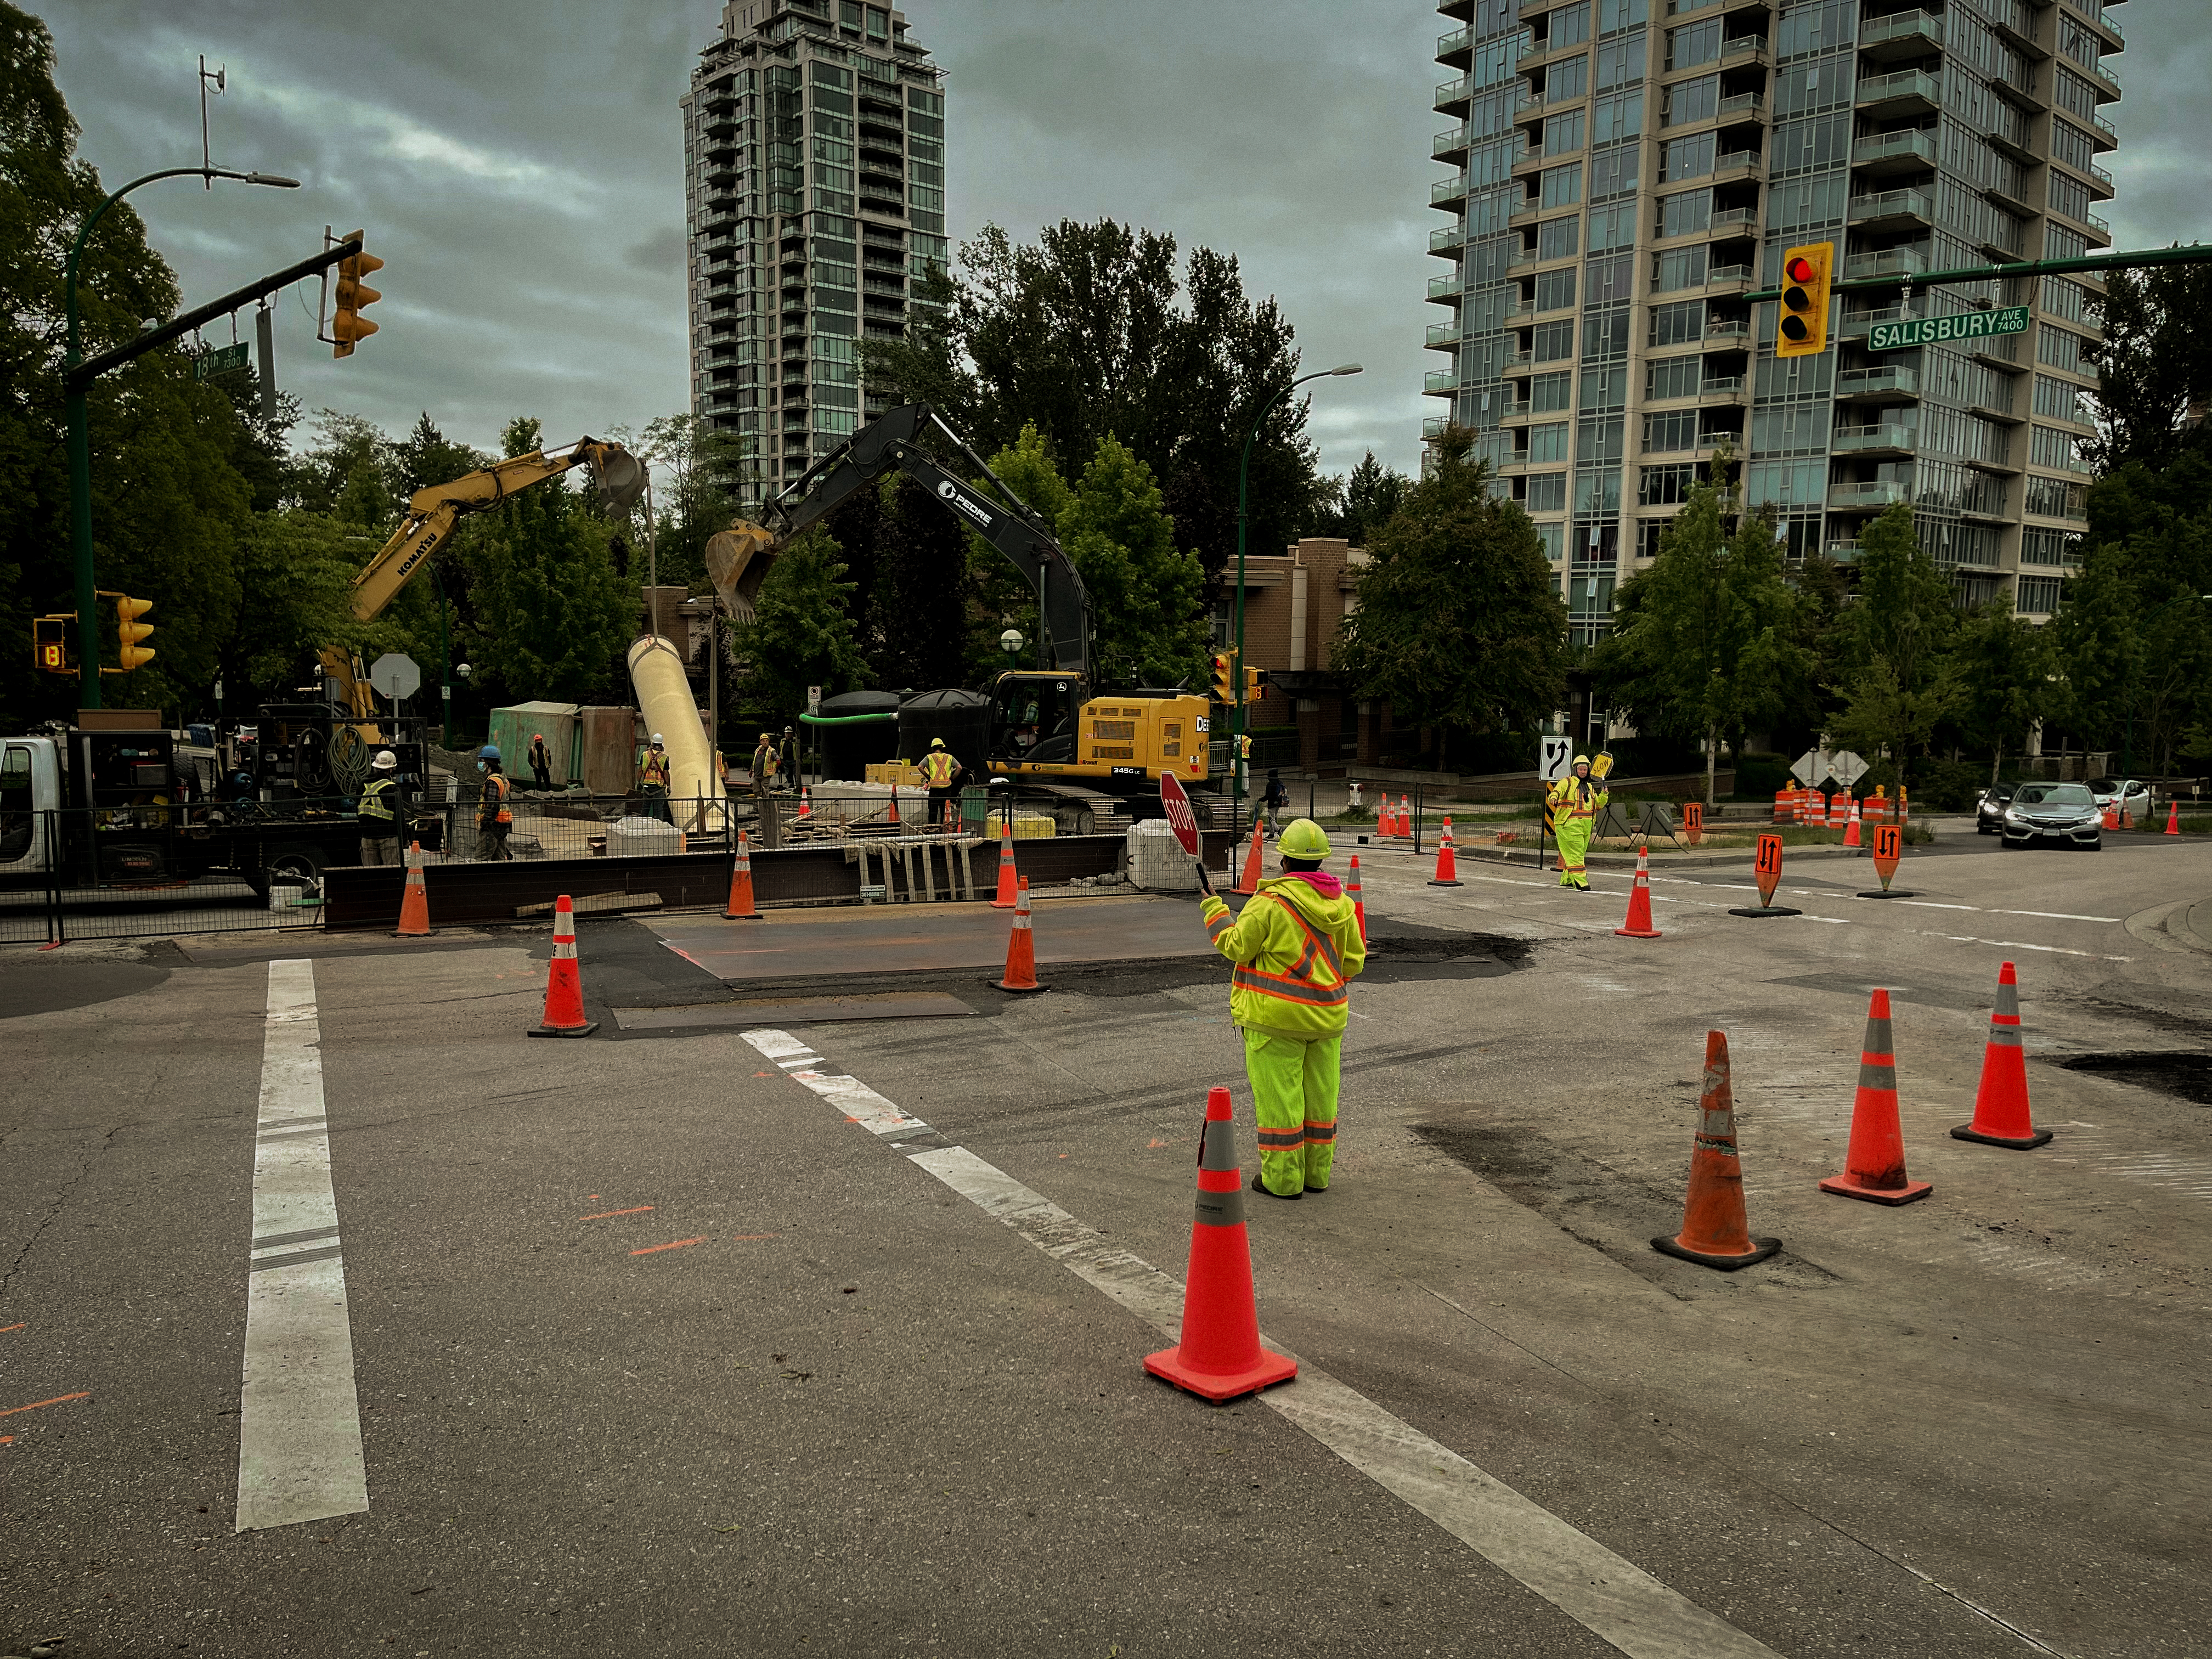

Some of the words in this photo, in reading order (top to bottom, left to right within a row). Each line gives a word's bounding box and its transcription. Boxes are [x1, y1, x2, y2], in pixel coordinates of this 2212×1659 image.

[2001, 309, 2021, 321] AVE
[1874, 312, 1999, 347] SALISBURY
[1997, 320, 2023, 332] 7400
[197, 353, 218, 378] 18th
[223, 356, 241, 369] 7300
[953, 501, 974, 517] UNDERGROUND
[956, 494, 992, 524] PEDRE
[397, 533, 437, 577] KOMATSU
[1593, 758, 1609, 775] SLOW
[1165, 798, 1193, 831] STOP
